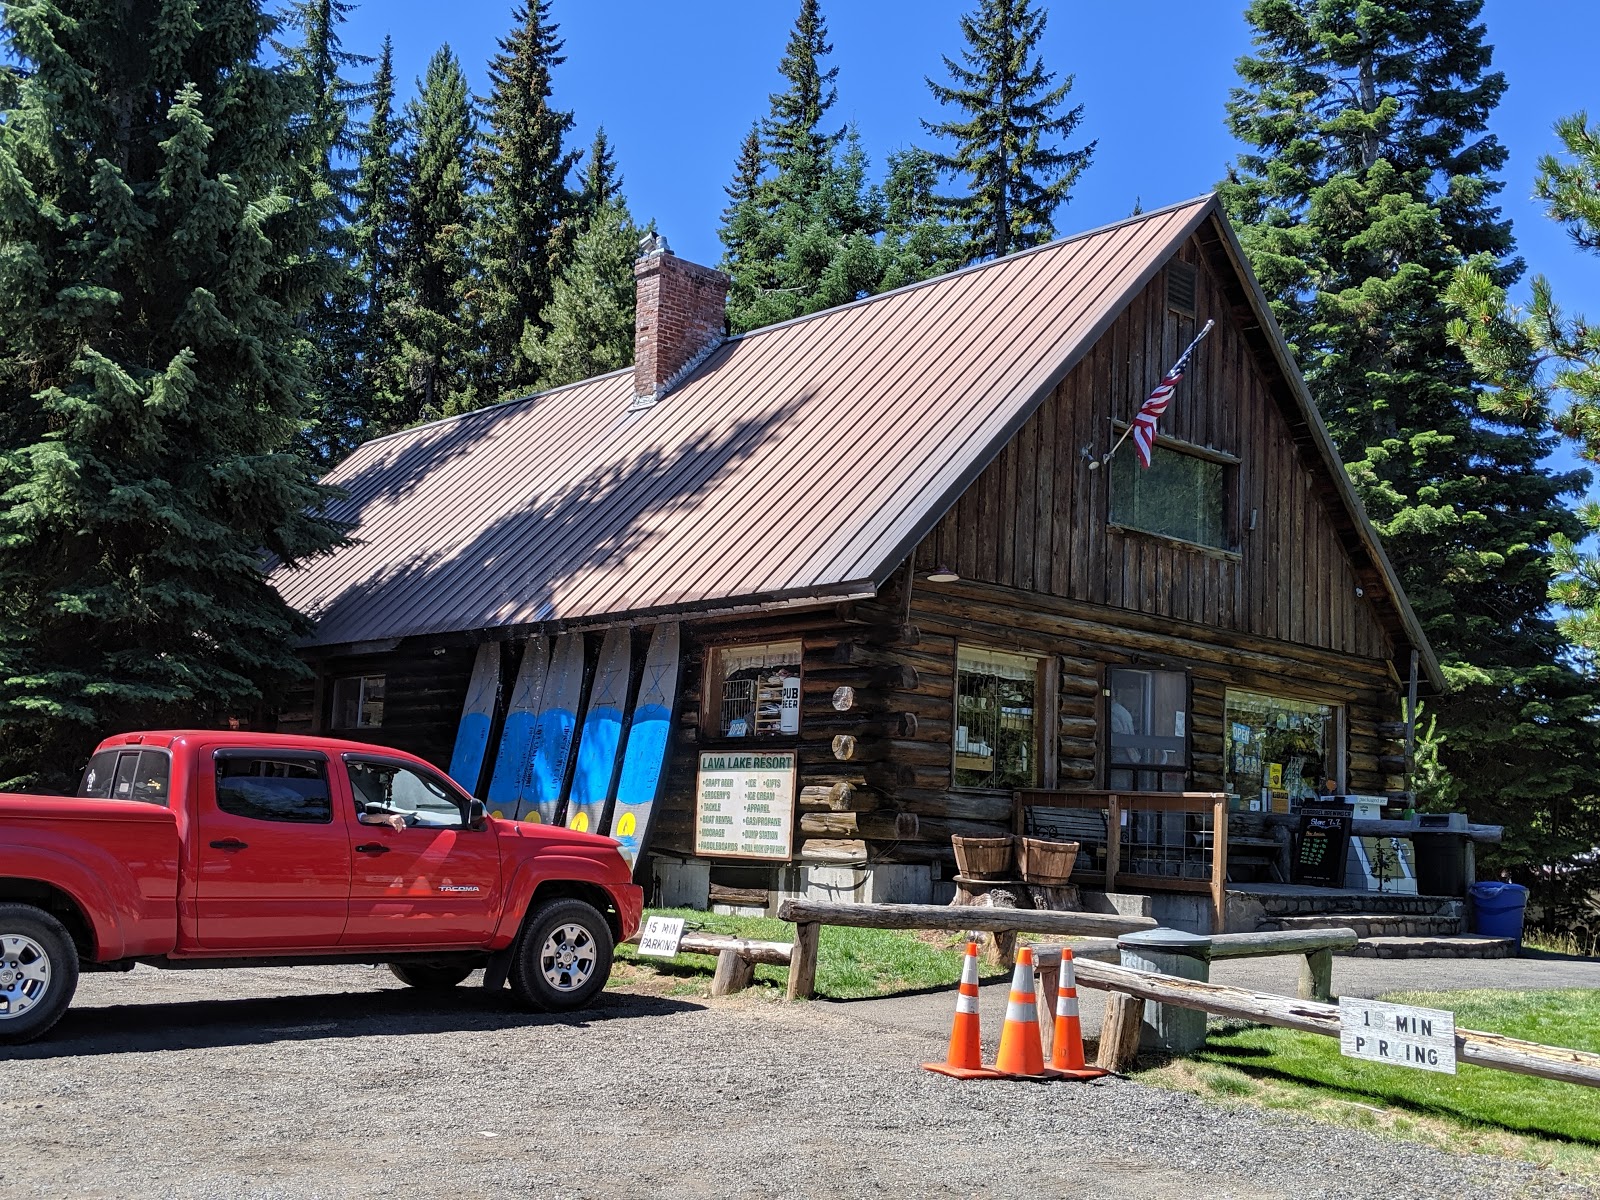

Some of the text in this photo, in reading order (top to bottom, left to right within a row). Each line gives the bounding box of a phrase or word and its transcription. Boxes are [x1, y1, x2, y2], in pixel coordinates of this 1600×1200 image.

[1233, 726, 1250, 742] OPEN
[702, 757, 792, 769] LAVA LAKE RESORT
[705, 779, 734, 787] CRAFT BEER
[748, 779, 757, 787] ICE
[766, 779, 781, 788] GIFTS
[757, 792, 775, 801] CREAM
[704, 803, 721, 811] TACKLE
[747, 804, 770, 813] APPAREL
[759, 831, 778, 840] STATION
[661, 922, 679, 935] MIN
[641, 937, 677, 951] PARKING
[1396, 1015, 1432, 1037] MIN
